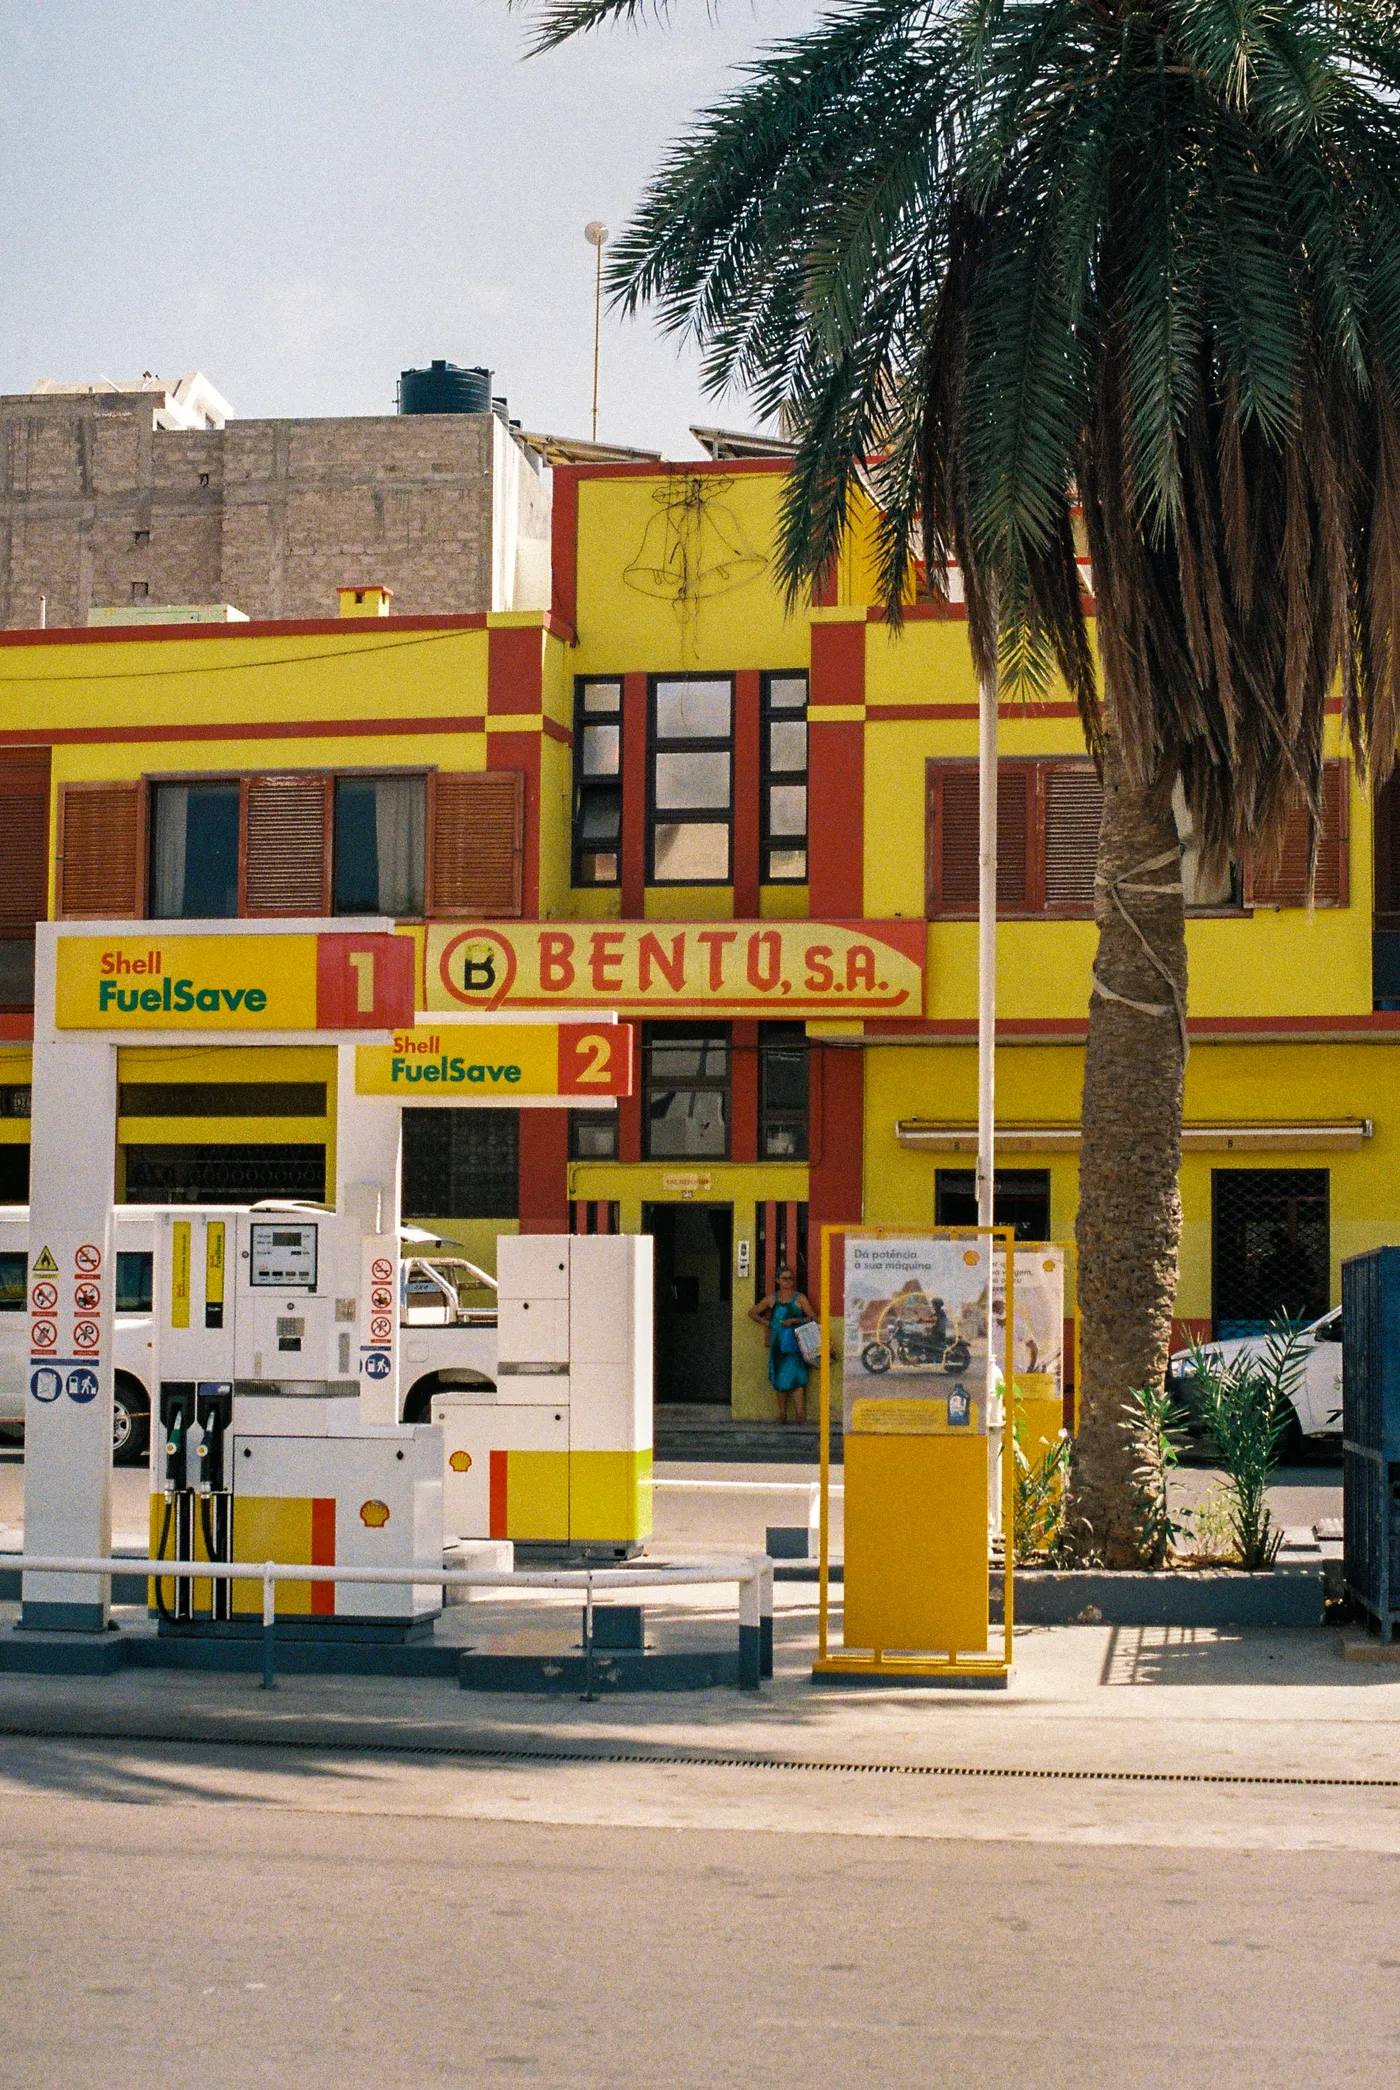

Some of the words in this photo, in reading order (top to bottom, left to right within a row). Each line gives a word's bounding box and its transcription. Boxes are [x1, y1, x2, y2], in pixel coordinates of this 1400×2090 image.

[101, 951, 161, 974] Shell
[537, 931, 792, 995] BENTO,
[803, 945, 889, 993] S.A.
[99, 977, 267, 1012] FuelSave
[349, 952, 374, 1012] 1
[392, 1036, 440, 1054] Shell
[575, 1034, 612, 1082] 2
[391, 1056, 521, 1083] FuelSave
[864, 1262, 883, 1270] sua
